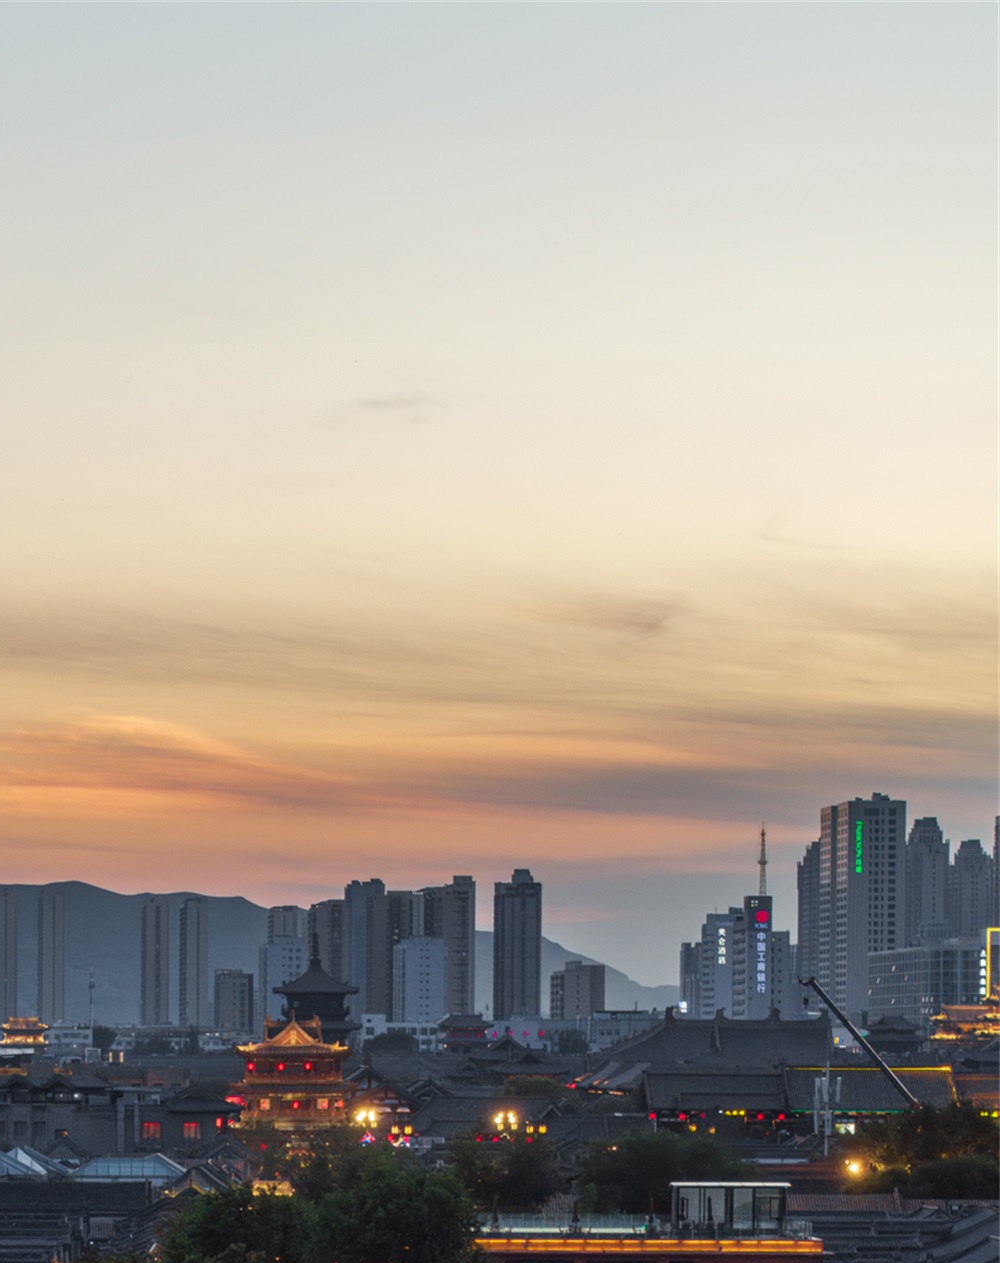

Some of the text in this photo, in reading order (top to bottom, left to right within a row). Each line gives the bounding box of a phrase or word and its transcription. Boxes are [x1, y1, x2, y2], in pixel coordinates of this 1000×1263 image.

[757, 932, 766, 993] 中国工商银行
